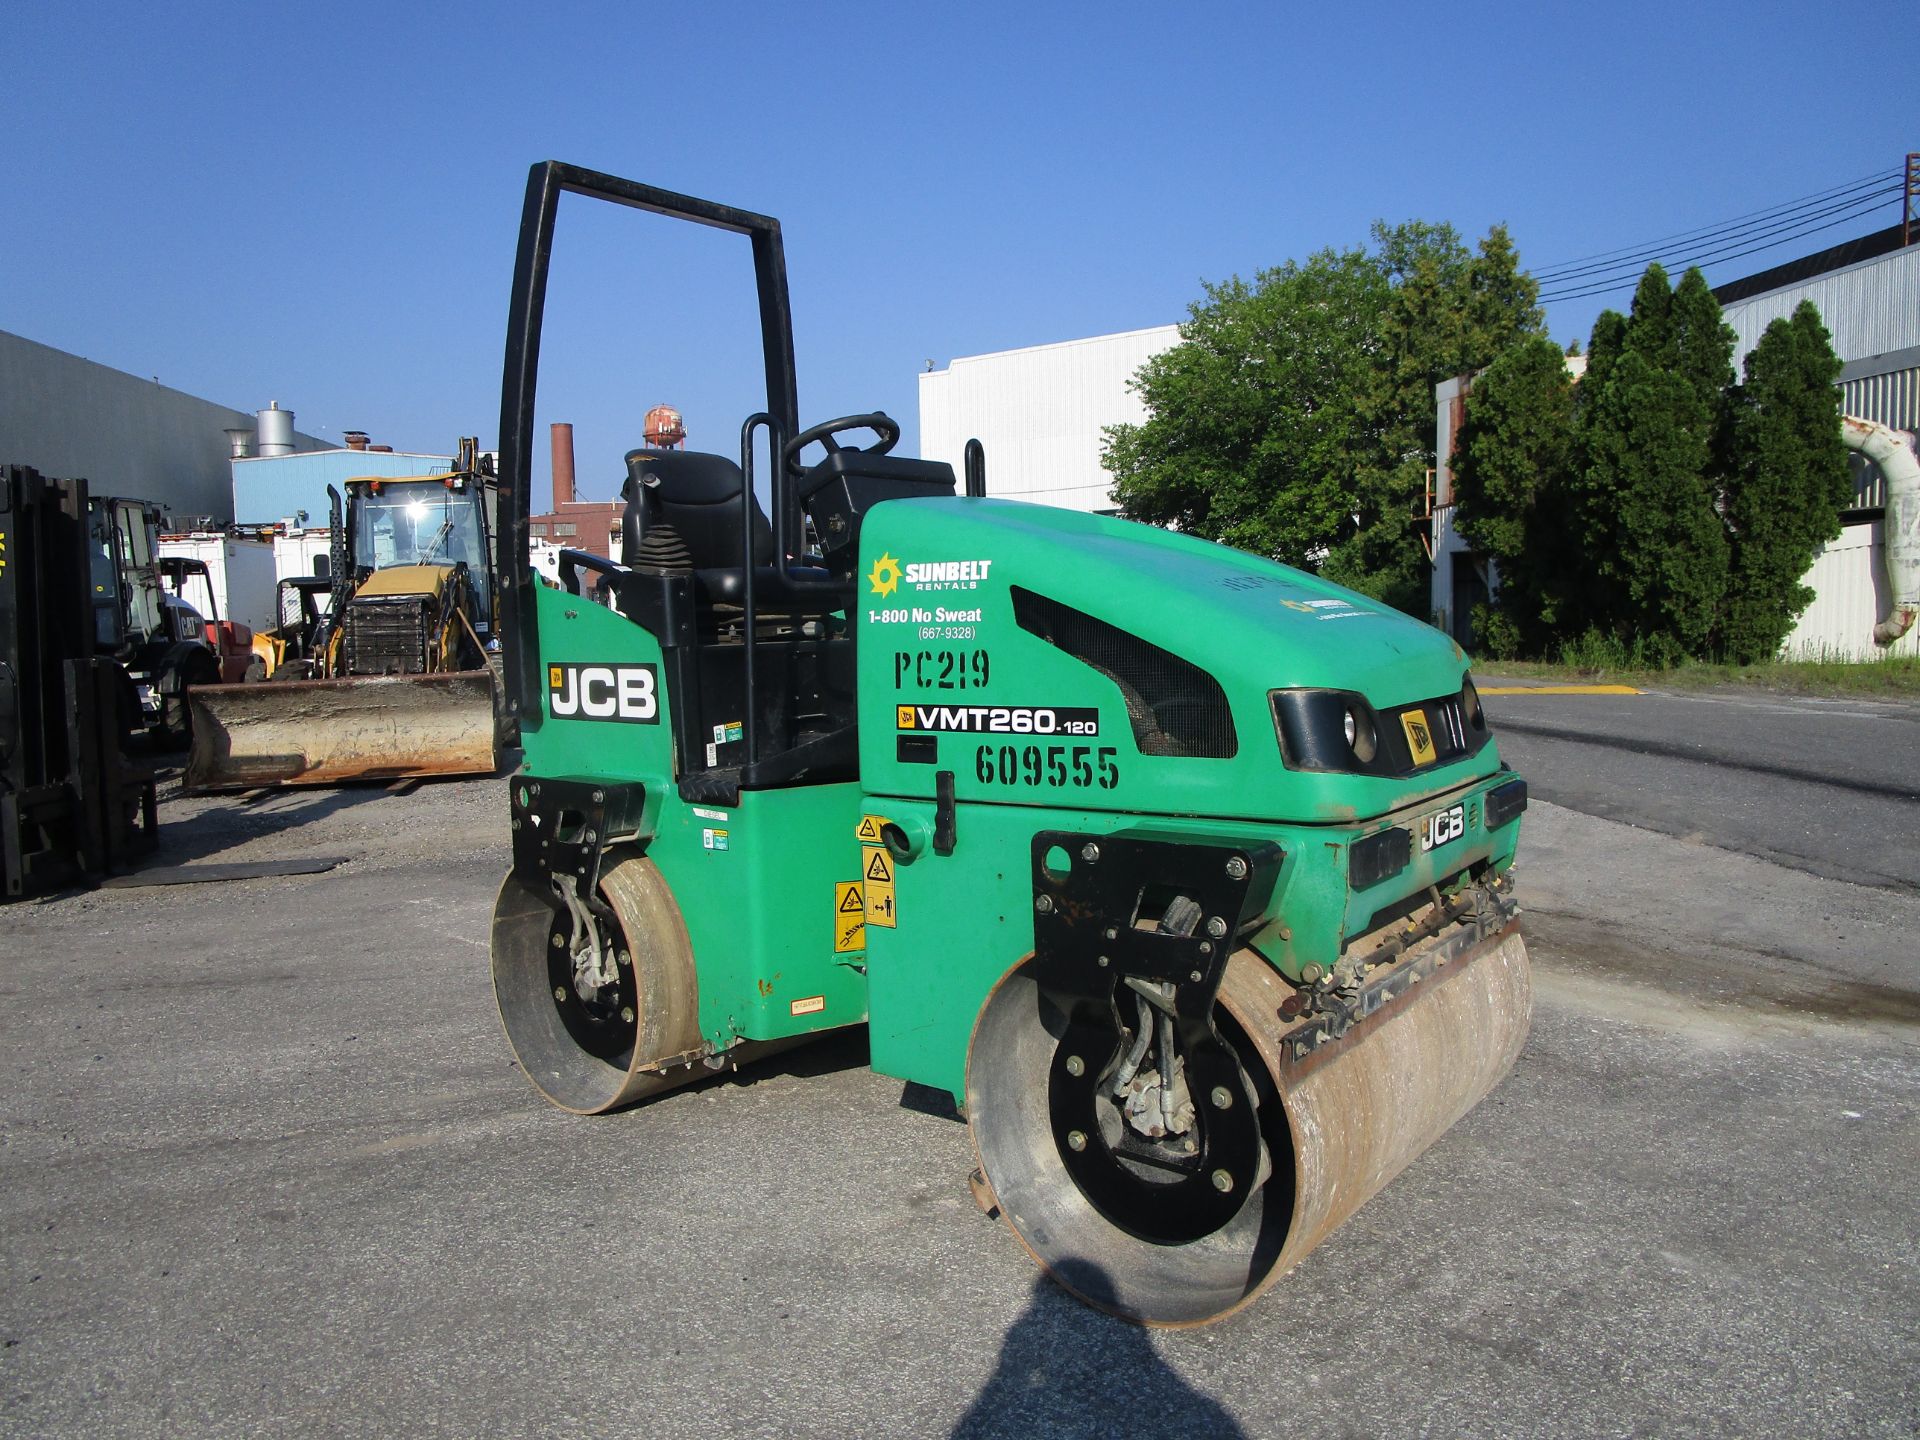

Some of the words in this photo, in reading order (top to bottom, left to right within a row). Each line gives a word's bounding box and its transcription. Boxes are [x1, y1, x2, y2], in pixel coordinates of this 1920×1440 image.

[905, 560, 992, 583] SUNBELT
[916, 581, 977, 591] RENTALS
[180, 616, 196, 636] CAT
[868, 609, 908, 624] 1-800
[911, 608, 932, 623] No
[935, 607, 982, 623] Sweat
[918, 626, 976, 640] (667-9328)
[895, 650, 990, 689] PC219
[551, 667, 657, 719] JCB
[975, 745, 1119, 790] 609555
[1421, 806, 1464, 851] JCB
